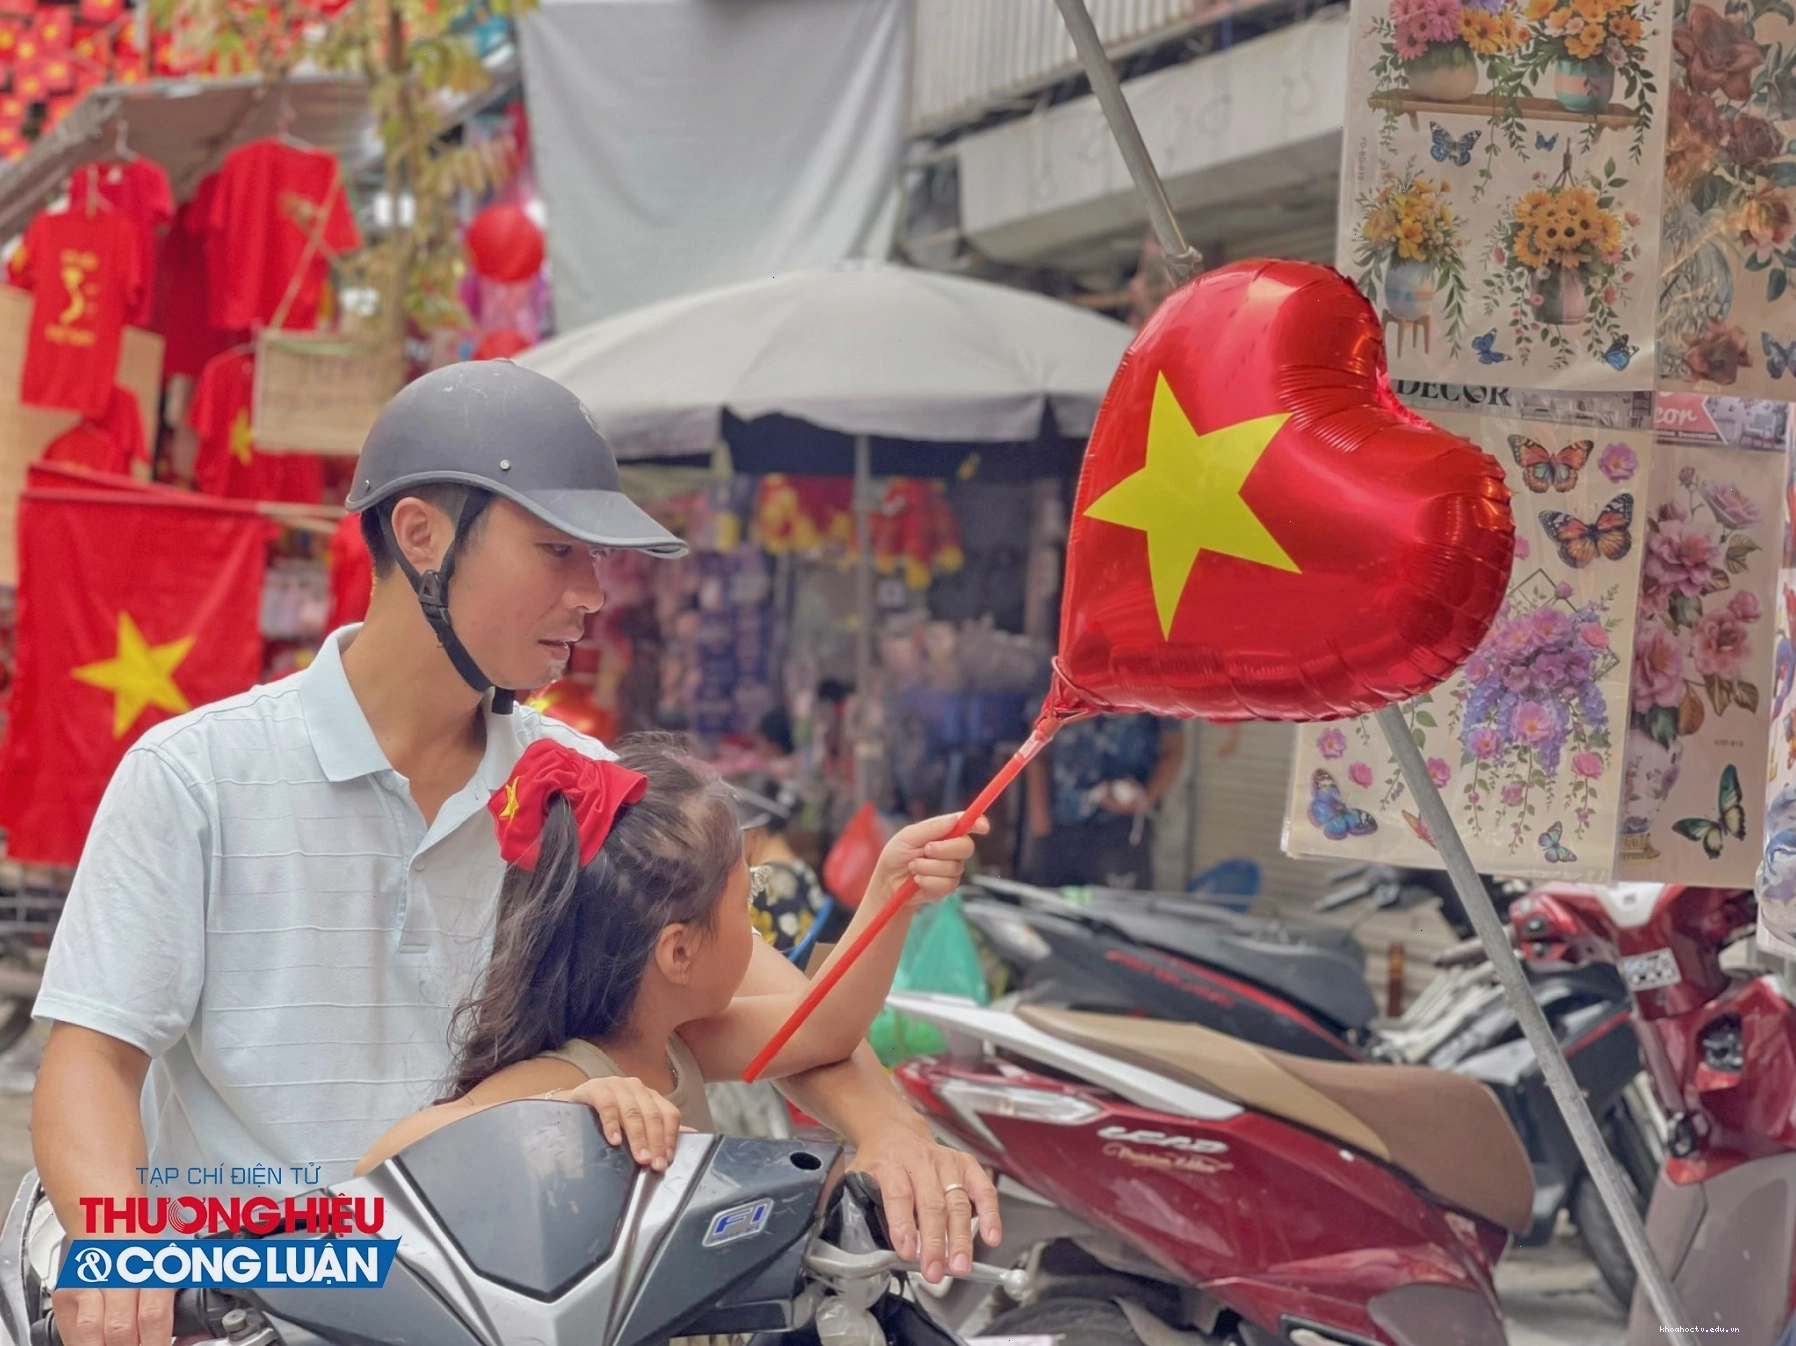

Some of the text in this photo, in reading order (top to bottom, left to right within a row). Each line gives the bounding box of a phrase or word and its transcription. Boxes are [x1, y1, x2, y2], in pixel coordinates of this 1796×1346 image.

[1396, 380, 1511, 407] DECOR
[1654, 406, 1698, 426] cor
[1097, 1126, 1229, 1154] LEAD
[712, 1203, 768, 1236] FI
